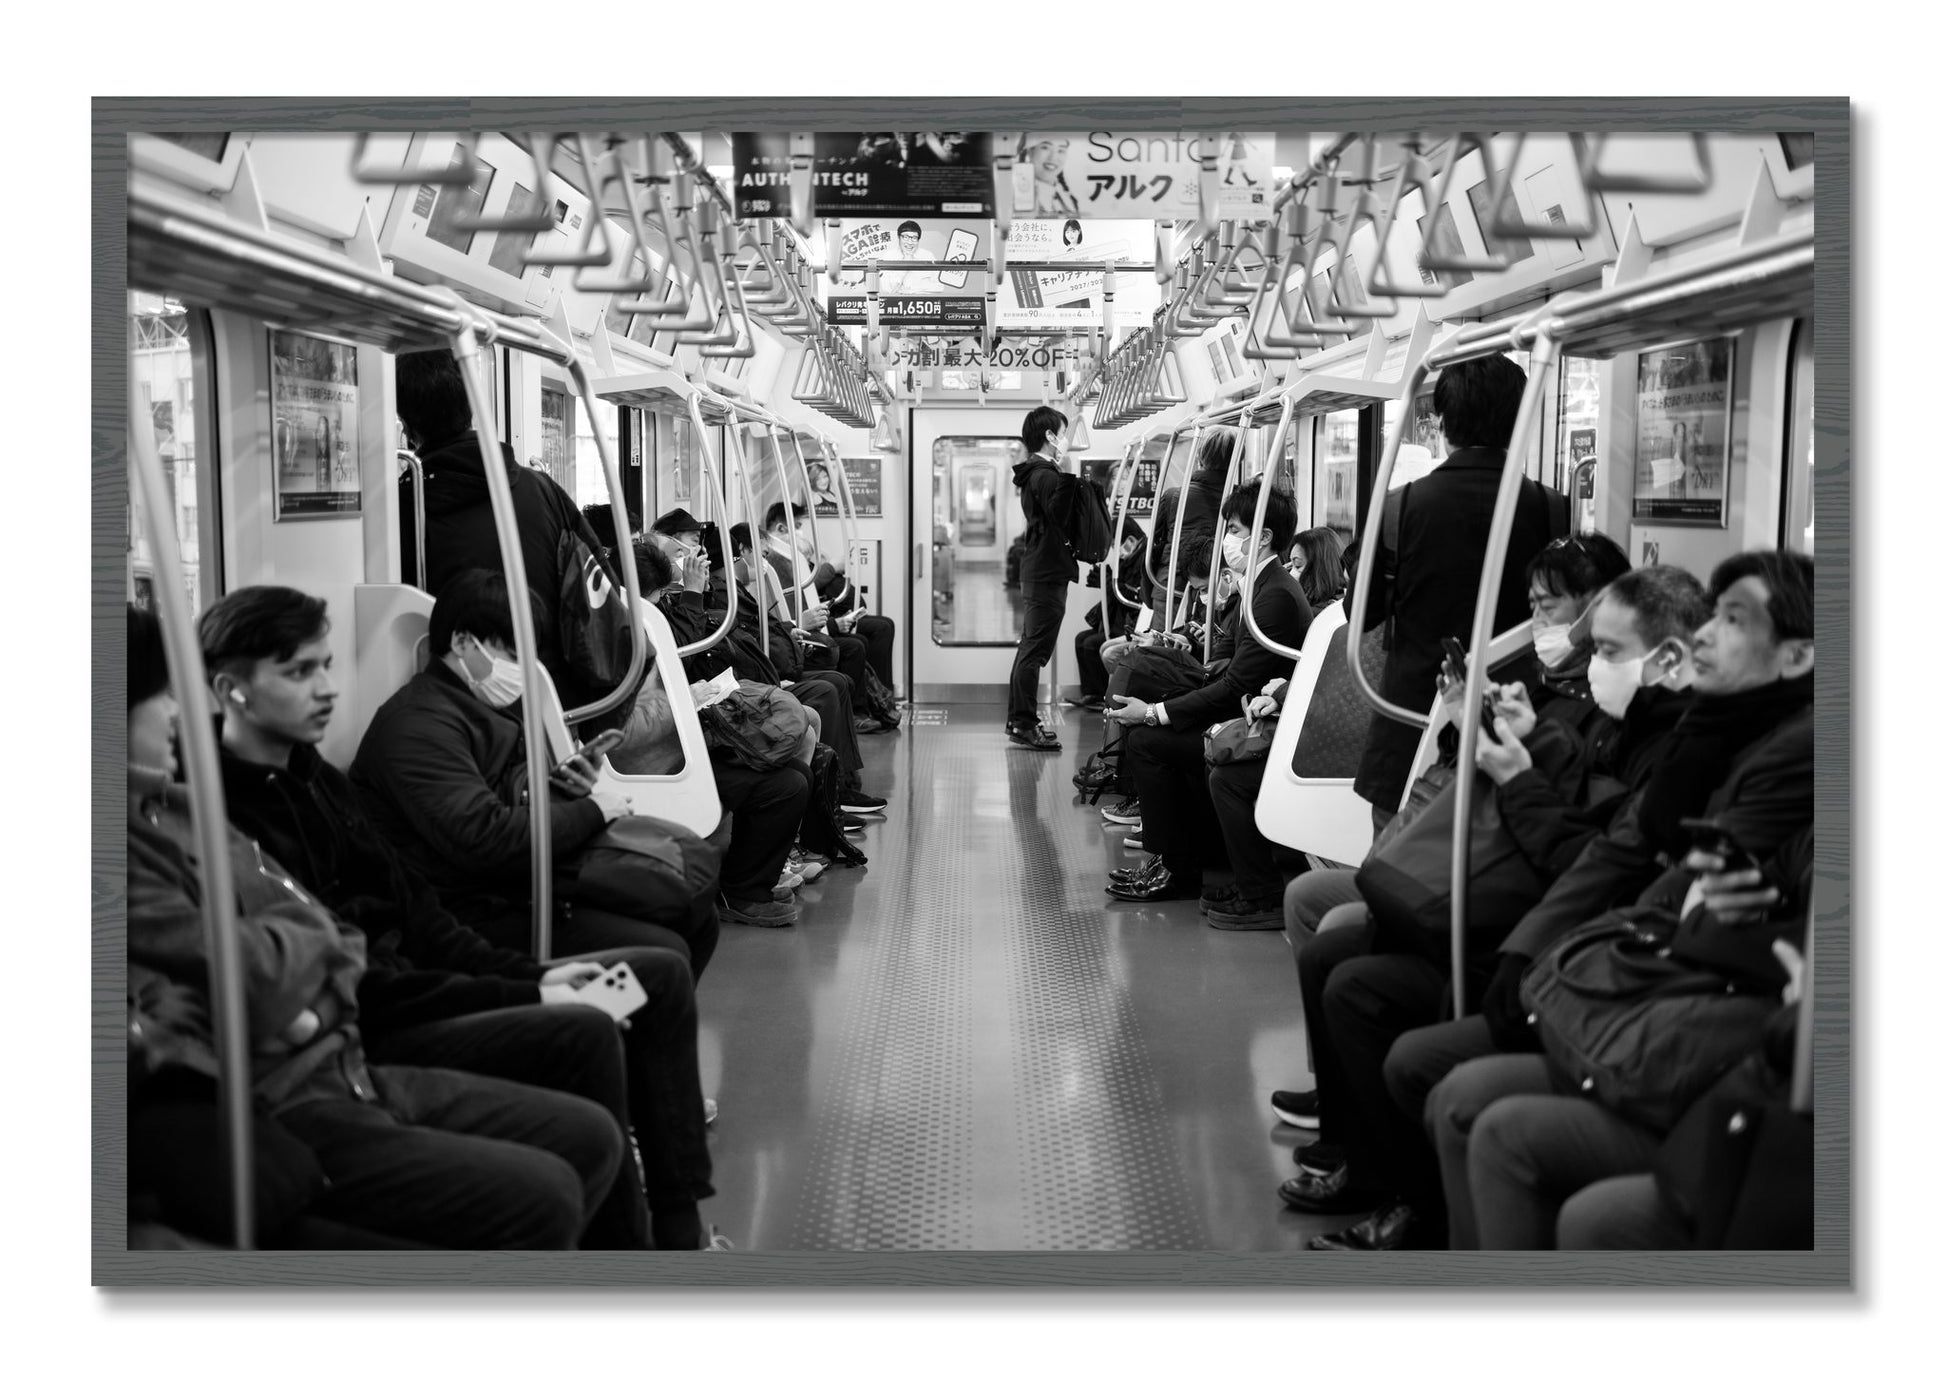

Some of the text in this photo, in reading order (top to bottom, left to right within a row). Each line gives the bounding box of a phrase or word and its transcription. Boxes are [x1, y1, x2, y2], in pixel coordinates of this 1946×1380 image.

[741, 172, 869, 186] AUTHTECH
[1087, 175, 1173, 202] アルク
[1070, 278, 1103, 291] 2027/202
